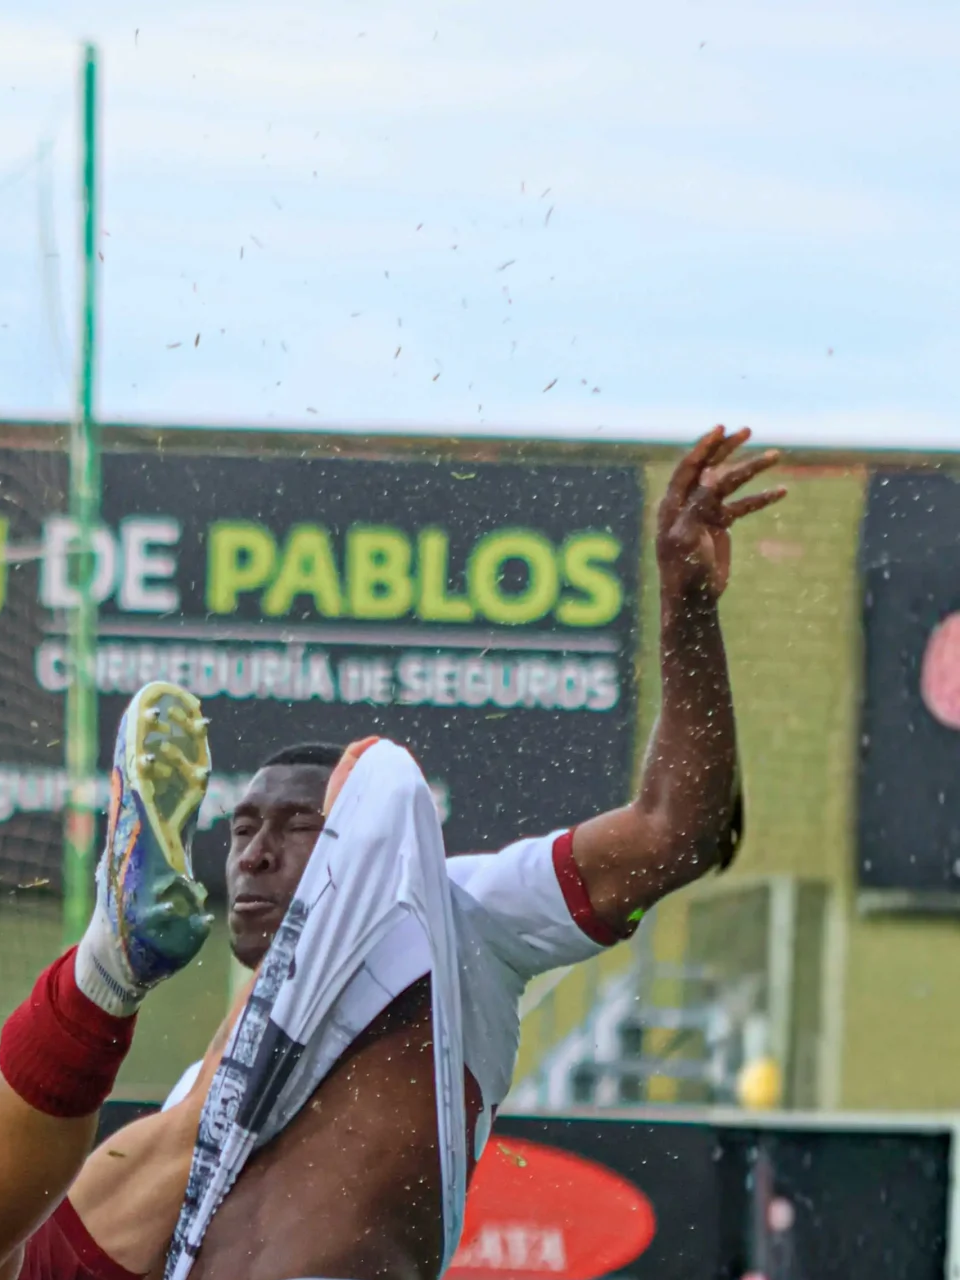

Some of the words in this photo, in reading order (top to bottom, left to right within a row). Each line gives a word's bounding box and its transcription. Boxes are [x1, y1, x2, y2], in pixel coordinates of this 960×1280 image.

[39, 515, 182, 613] DE
[204, 519, 624, 629] PABLOS
[35, 637, 338, 700] CRREDURÍA
[397, 654, 620, 713] SEGUROS
